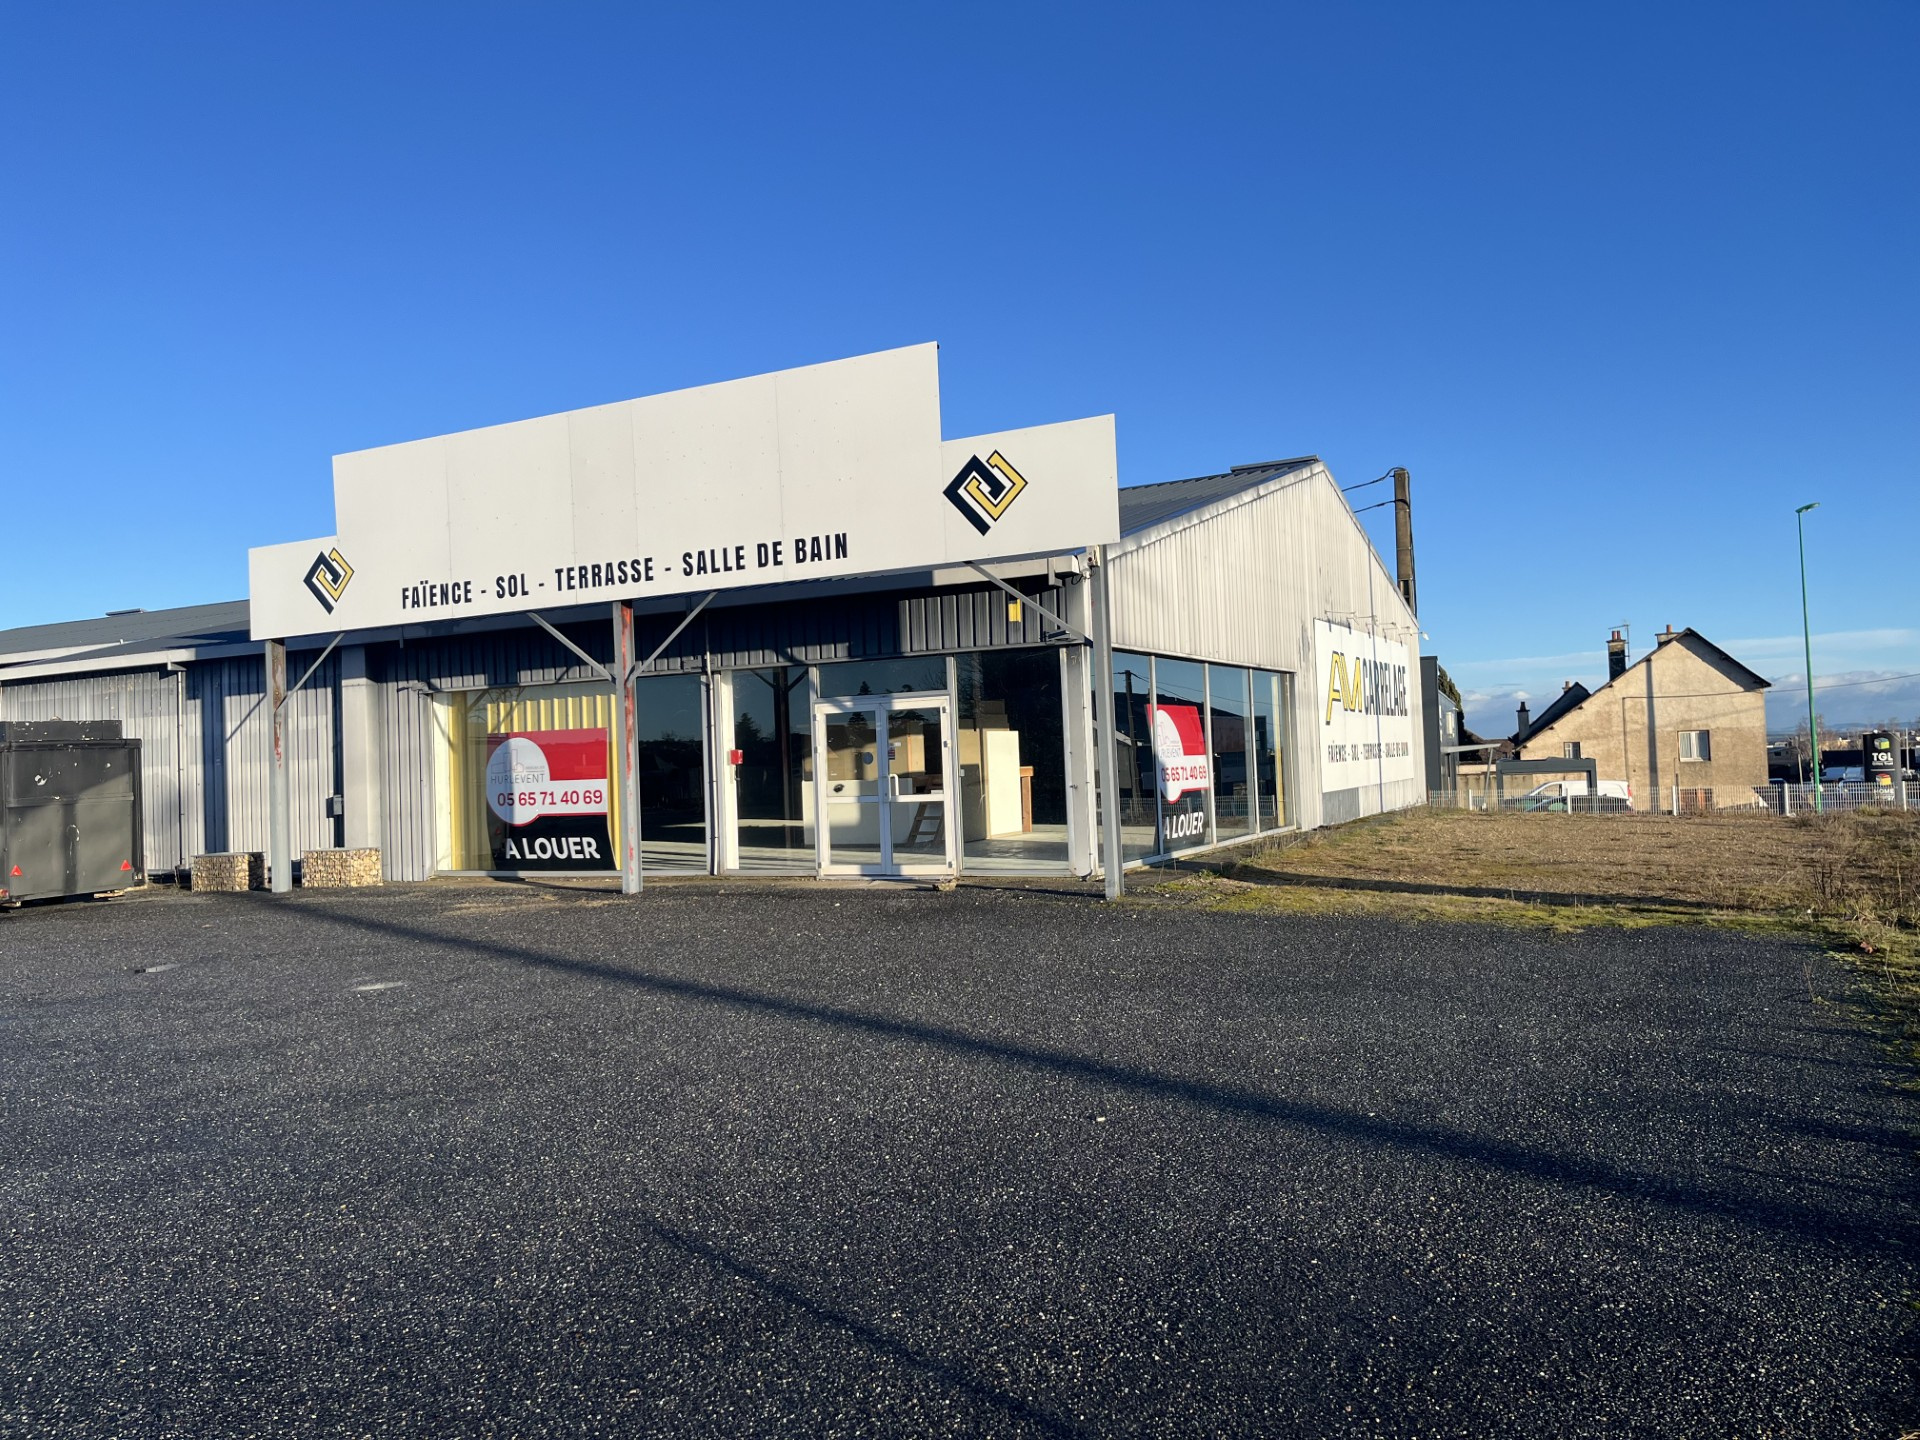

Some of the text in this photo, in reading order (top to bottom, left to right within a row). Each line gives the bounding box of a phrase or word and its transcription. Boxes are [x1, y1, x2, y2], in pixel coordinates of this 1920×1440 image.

[402, 580, 472, 610] FAÏENCE
[496, 573, 530, 599] SOL
[555, 557, 654, 592] TERRASSE
[682, 545, 747, 577] SALLE
[756, 540, 783, 568] DE
[794, 532, 849, 564] BAIN
[1363, 658, 1408, 716] CARRELAGE
[1872, 752, 1893, 761] TGL
[491, 773, 544, 784] HURLEVENT
[1171, 766, 1180, 781] 65
[1181, 766, 1189, 780] 71
[1190, 766, 1199, 780] 40
[497, 789, 603, 806] 05 65 71 40 69
[1163, 812, 1204, 839] A LOUER
[506, 837, 600, 859] A LOUER
